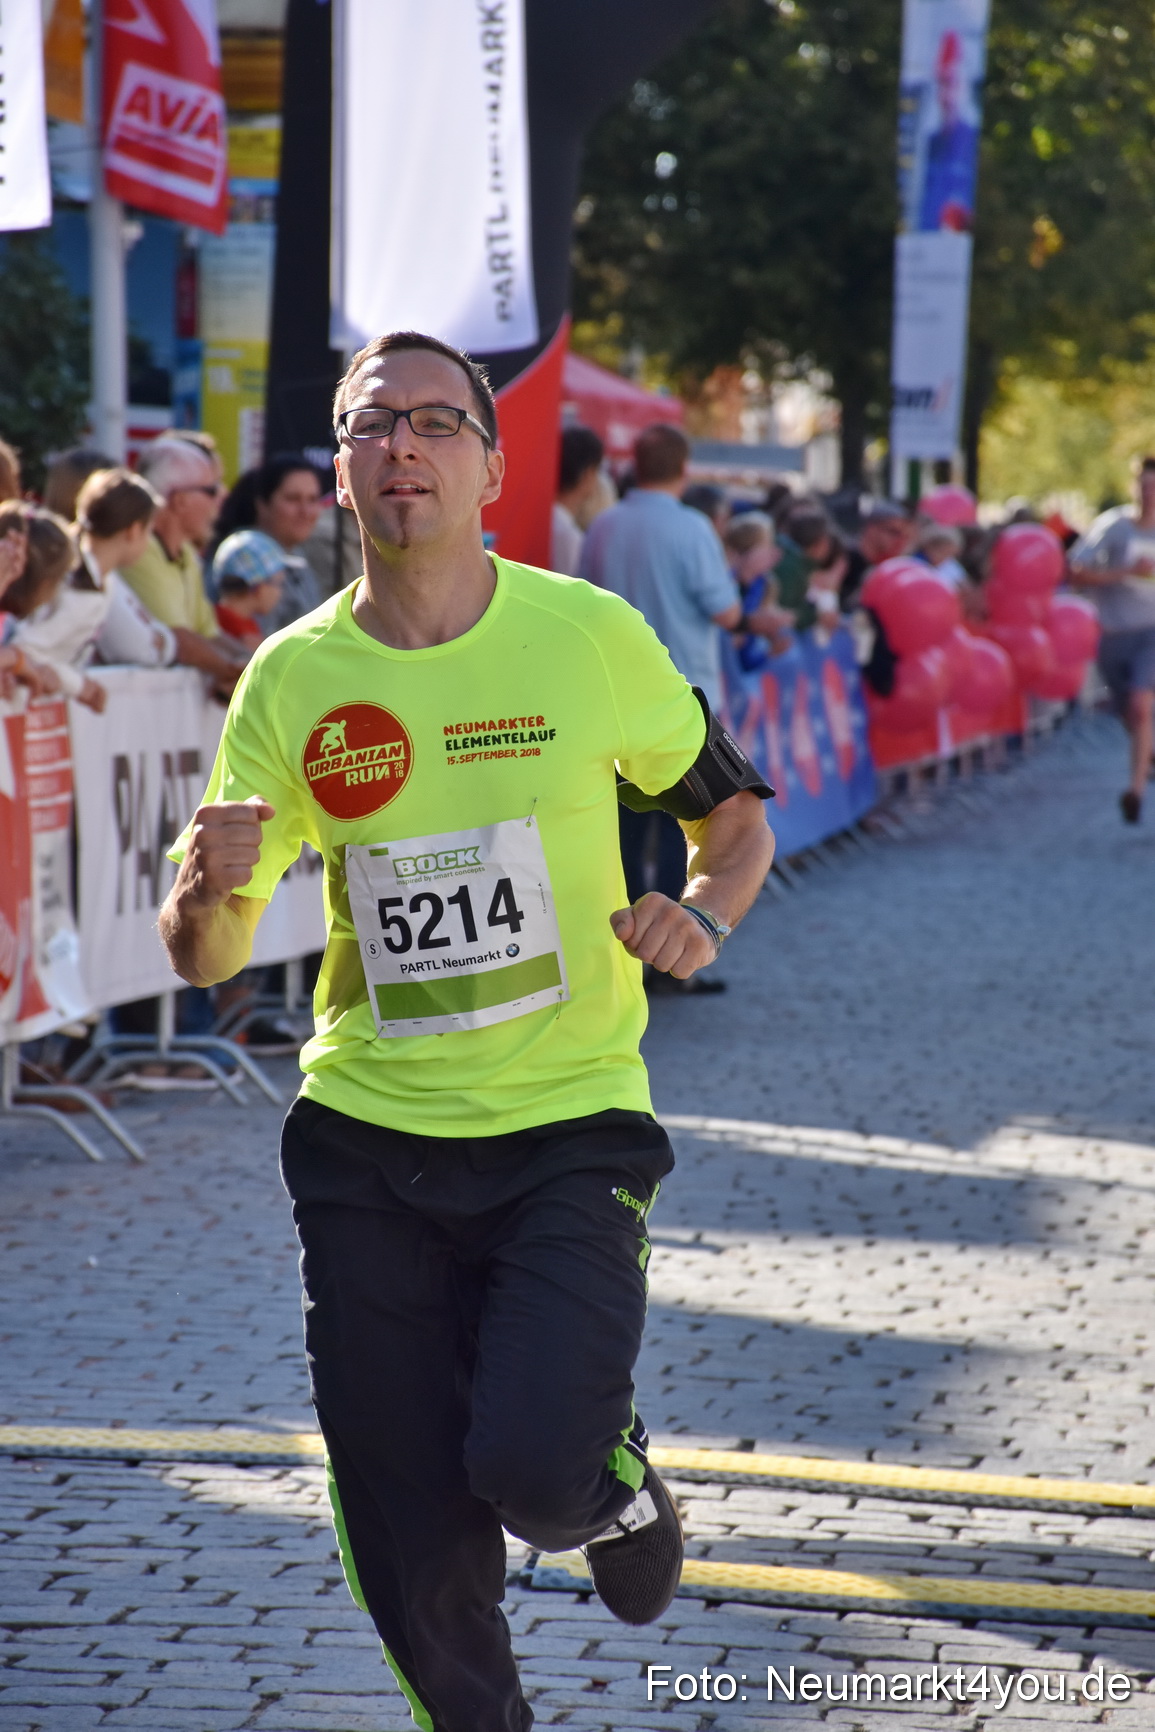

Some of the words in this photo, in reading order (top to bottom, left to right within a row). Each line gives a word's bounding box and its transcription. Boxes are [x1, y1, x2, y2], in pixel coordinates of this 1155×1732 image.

[122, 84, 220, 148] AVIA
[485, 203, 514, 323] PARTL
[443, 715, 546, 736] NEUMARKTER
[445, 728, 557, 751] ELEMENTELAUF
[308, 743, 403, 779] URBANIAN
[519, 747, 542, 758] 2018
[345, 764, 391, 787] RUN
[393, 761, 404, 770] 20
[392, 845, 482, 878] BOCK
[396, 876, 423, 886] inspired
[433, 872, 453, 880] smart
[454, 866, 486, 876] concepts
[377, 877, 525, 955] 5214
[369, 943, 377, 955] S
[399, 960, 441, 975] PARTL
[442, 950, 502, 969] Neumarkt
